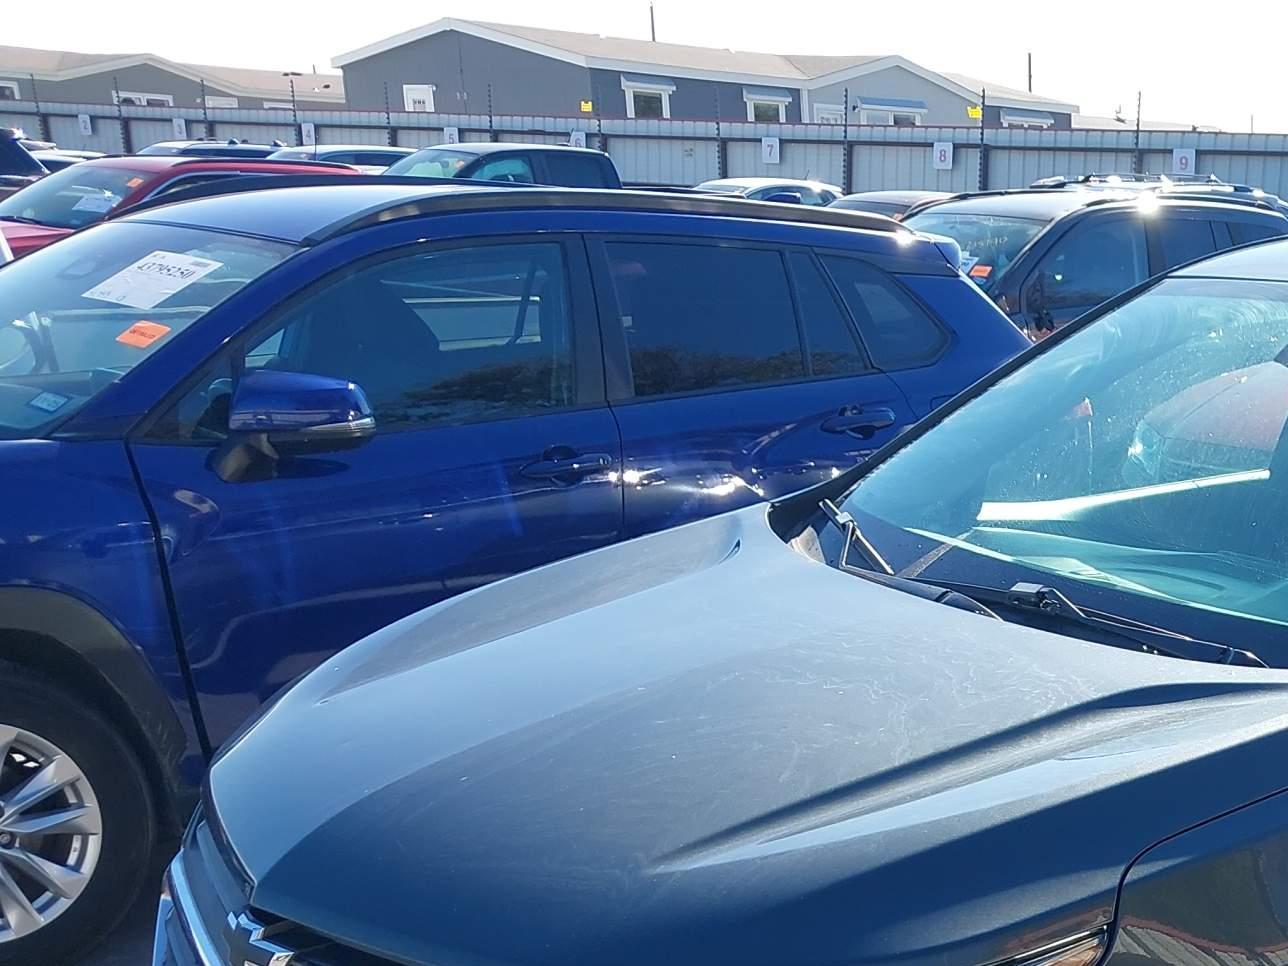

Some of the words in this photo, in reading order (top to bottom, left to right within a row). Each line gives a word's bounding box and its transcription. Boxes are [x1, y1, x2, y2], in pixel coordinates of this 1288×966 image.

[448, 133, 455, 145] 5
[767, 143, 774, 157] 7
[939, 149, 947, 162] 8
[1179, 155, 1189, 171] 9
